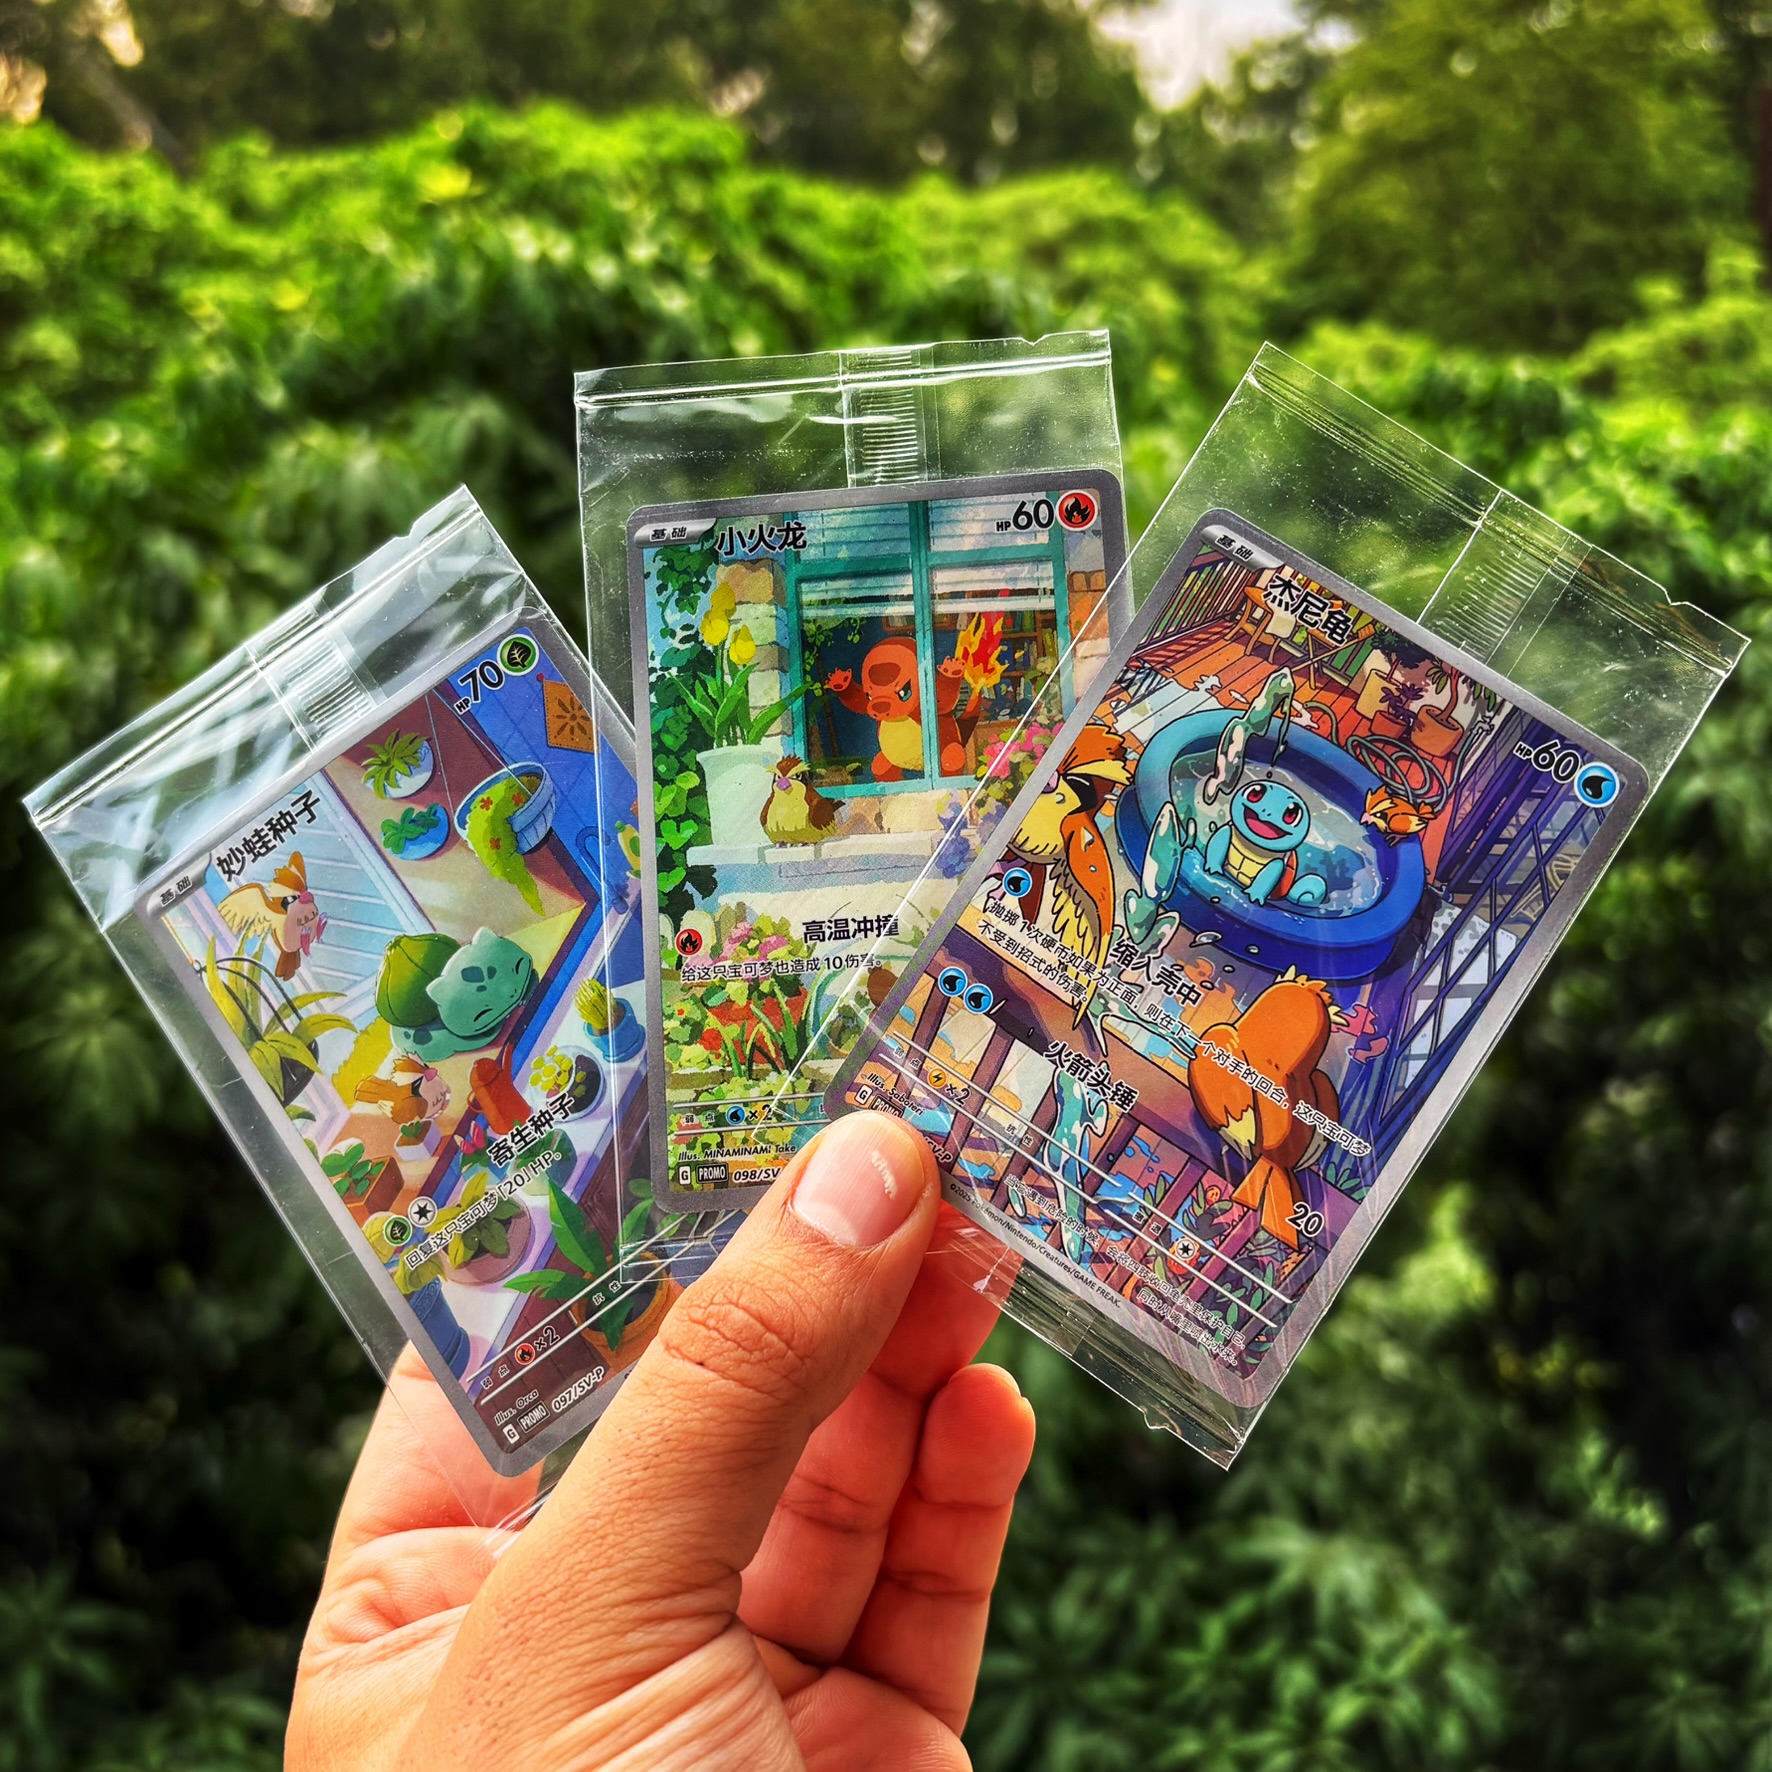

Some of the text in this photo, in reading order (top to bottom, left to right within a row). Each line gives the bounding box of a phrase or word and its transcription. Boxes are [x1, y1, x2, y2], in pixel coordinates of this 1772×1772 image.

[651, 527, 688, 541] 基础
[996, 499, 1055, 533] HP 60
[716, 521, 807, 557] 小火龙
[1216, 534, 1254, 561] 基础
[1261, 573, 1354, 646] 杰尼龟
[454, 660, 504, 714] HP 70
[1514, 740, 1580, 783] HP 60
[216, 789, 321, 882] 妙蛙种子
[160, 876, 192, 906] 基础
[802, 914, 900, 944] 高温冲撞
[1109, 938, 1203, 1006] 缩入壳中
[858, 1089, 869, 1101] G
[867, 1072, 926, 1116] Illus. Saboteri
[1043, 1040, 1139, 1114] 火箭头锤
[487, 1093, 576, 1167] 寄生种子
[678, 1150, 701, 1162] Illus.
[775, 1144, 797, 1154] Take
[681, 1169, 690, 1181] G
[698, 1166, 727, 1180] PROMO
[1287, 1203, 1324, 1235] 20
[494, 1388, 540, 1426] Illus. Orca
[505, 1427, 517, 1441] G
[520, 1404, 548, 1431] PROMO
[552, 1366, 606, 1412] 097/SV-P
